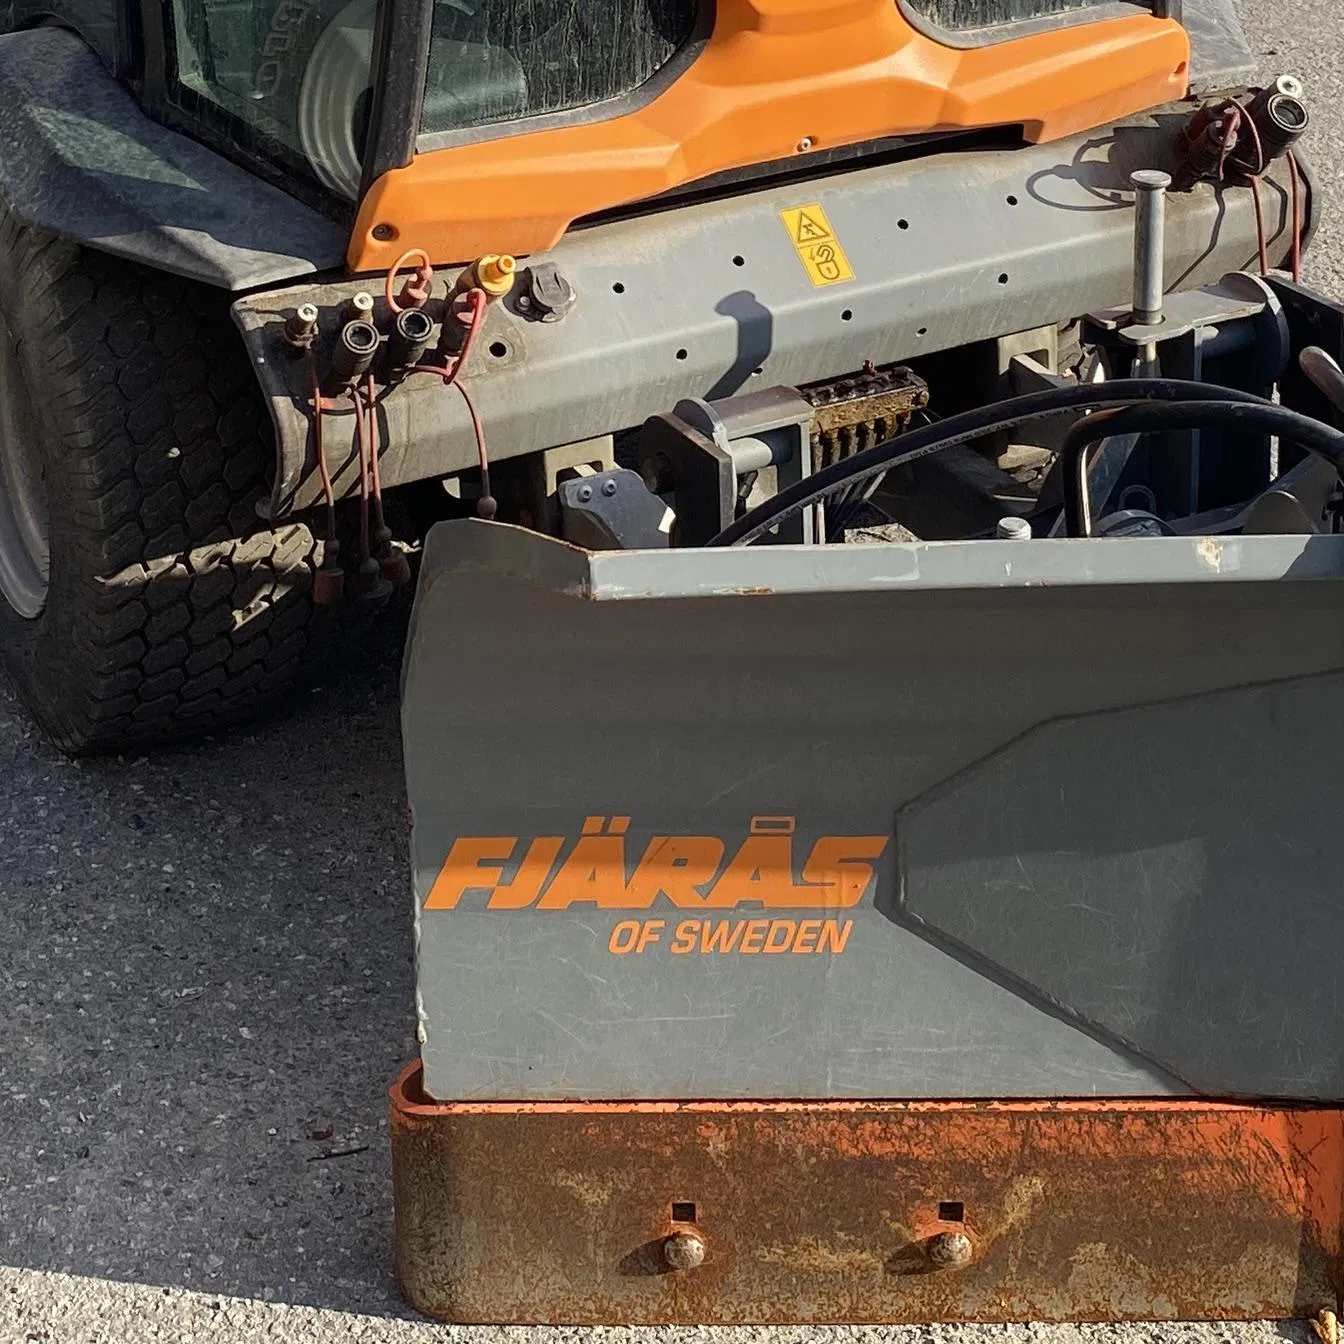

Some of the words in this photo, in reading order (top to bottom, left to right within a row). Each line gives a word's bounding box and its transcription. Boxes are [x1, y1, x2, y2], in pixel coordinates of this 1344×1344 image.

[422, 816, 889, 910] FJÄRÅS
[608, 920, 666, 954] OF
[670, 919, 854, 954] SWEDEN
